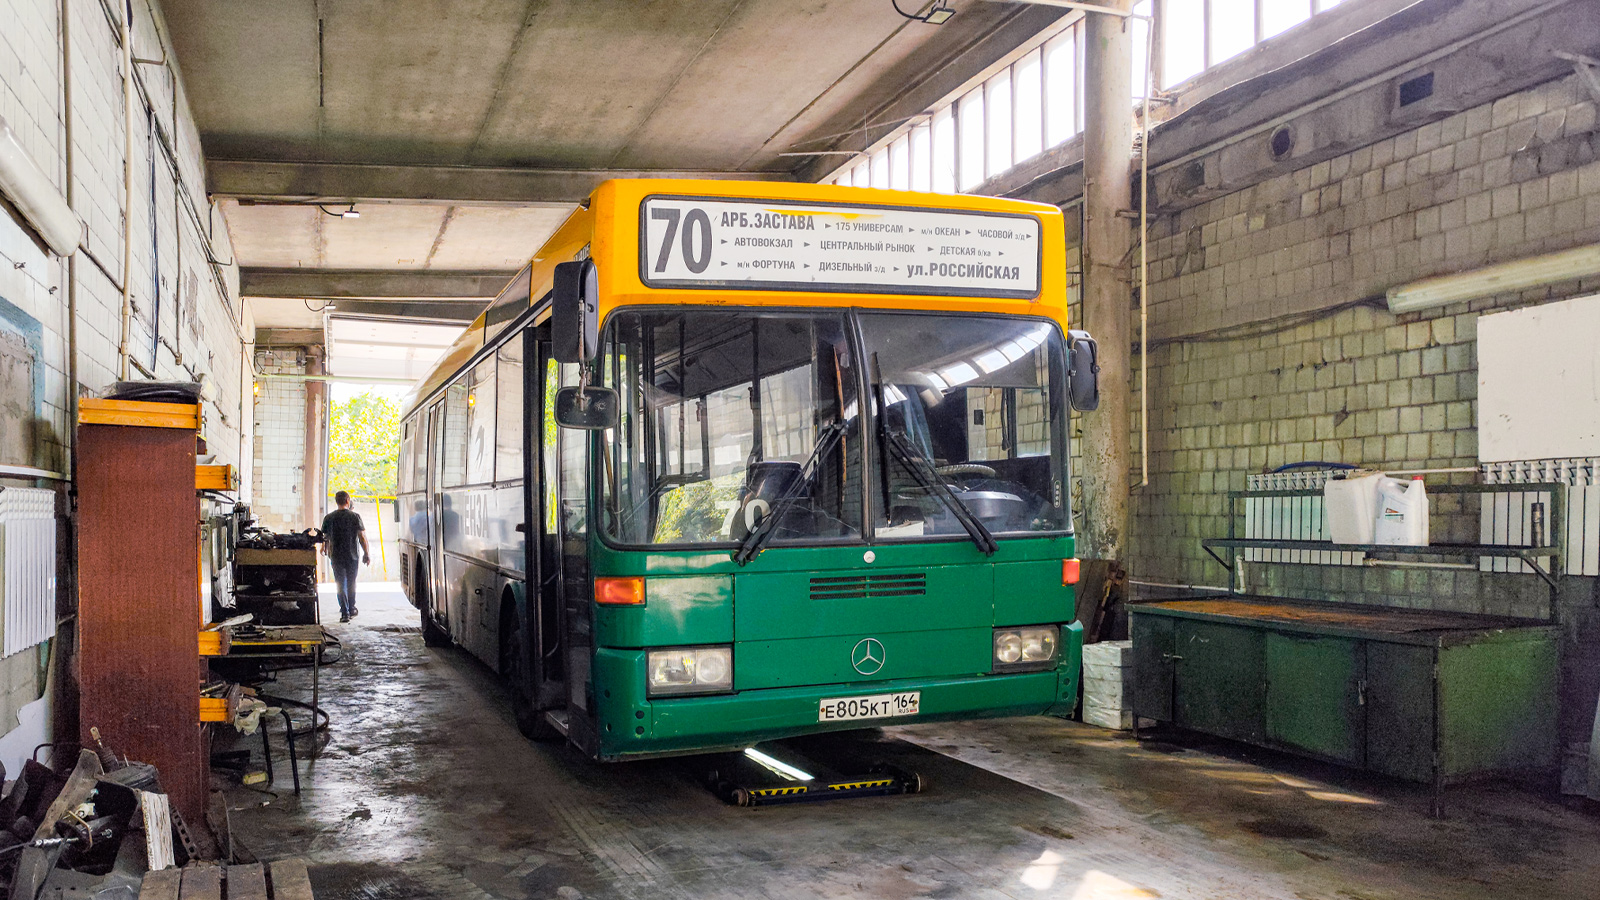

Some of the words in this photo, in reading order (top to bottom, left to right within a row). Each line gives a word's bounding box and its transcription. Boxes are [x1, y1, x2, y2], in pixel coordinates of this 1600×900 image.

[720, 211, 815, 231] АРБ.ЗАСТАВА
[835, 221, 851, 231] 175
[852, 222, 904, 234] УНИВЕРСАМ
[934, 226, 961, 236] ОКЕАН
[977, 228, 1013, 240] ЧАСОВОЙ
[651, 207, 713, 274] 70
[734, 237, 793, 249] АВТОВОКЗАЛ
[820, 240, 884, 252] ЦЕНТРАЛЬНЫЙ
[885, 243, 915, 253] РЫНОК
[939, 246, 976, 256] ДЕТСКАЯ
[752, 259, 796, 270] ФОРТУНА
[818, 261, 873, 272] ДИЗЕЛЬНЫЙ
[906, 261, 1020, 281] ул.РОССИЙСКАЯ
[714, 498, 772, 537] 70
[825, 699, 890, 719] Е805КТ
[893, 694, 916, 709] 164
